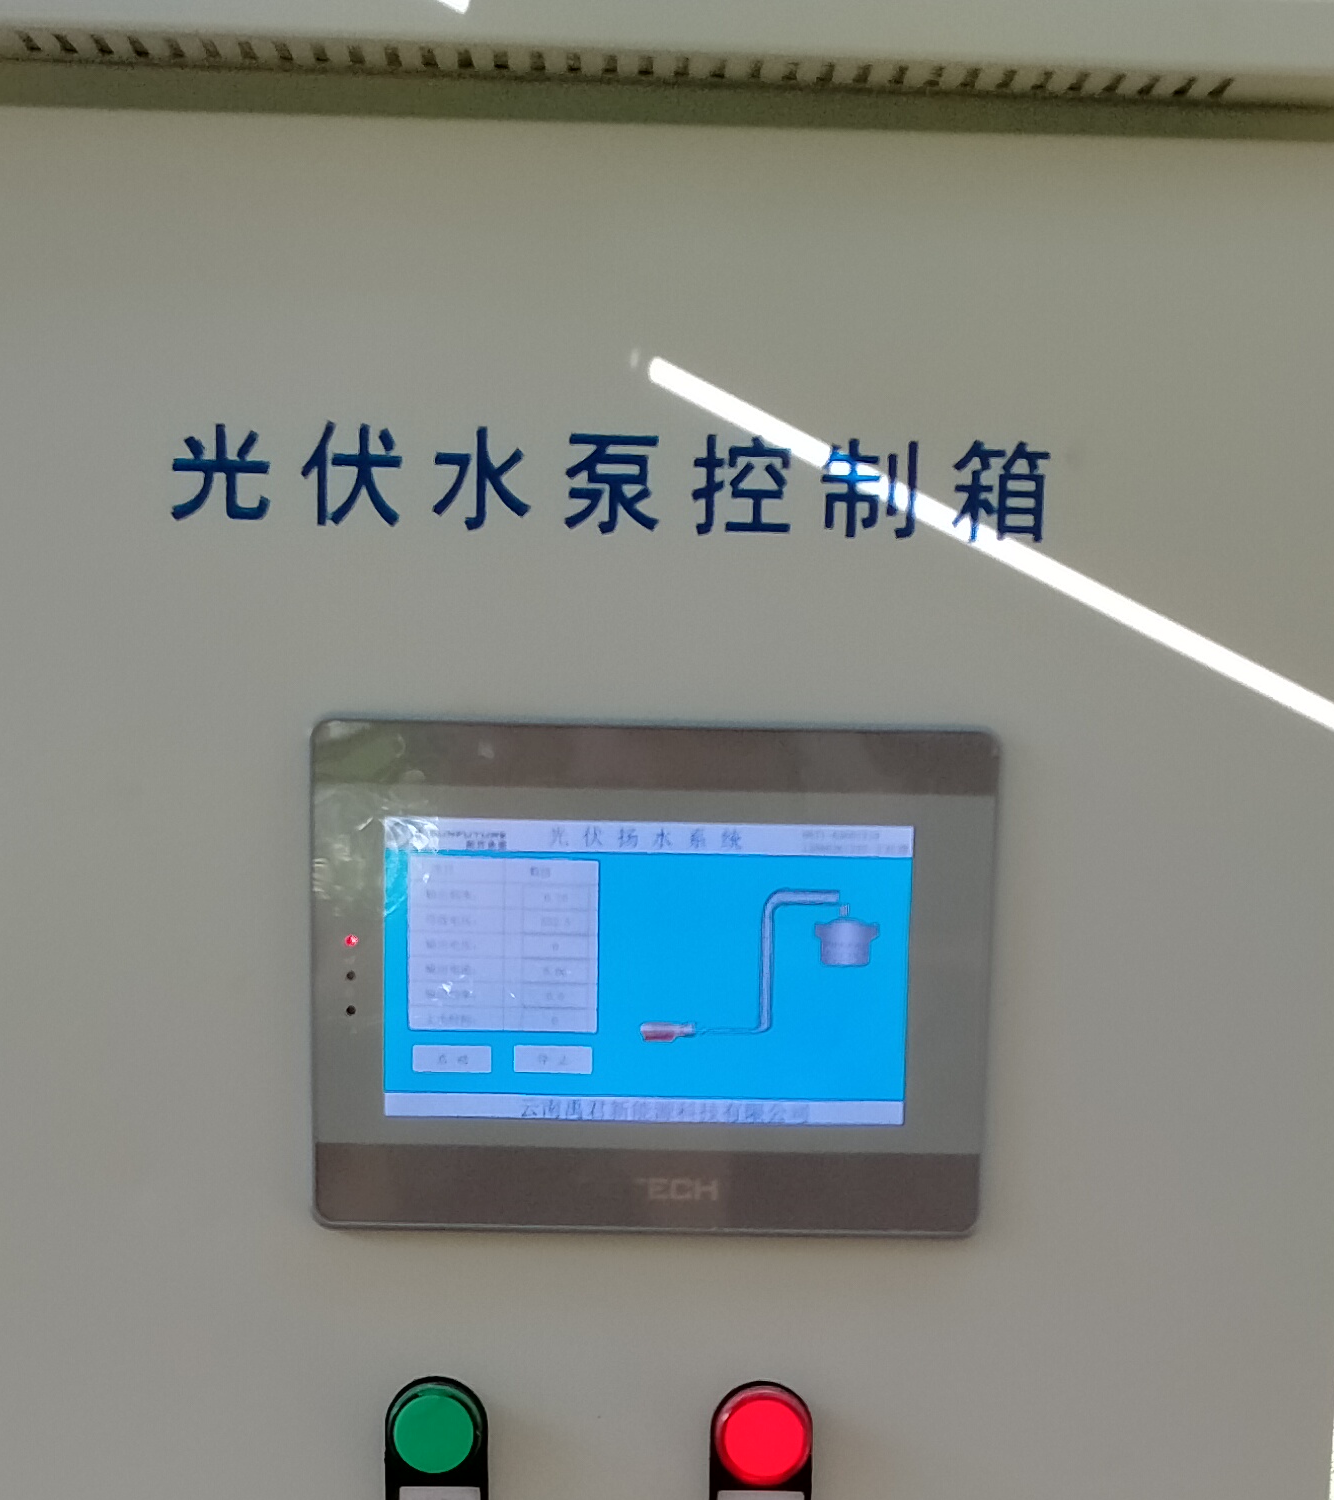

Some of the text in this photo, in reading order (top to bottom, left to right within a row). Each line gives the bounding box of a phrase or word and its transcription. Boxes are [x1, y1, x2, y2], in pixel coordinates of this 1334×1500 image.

[171, 420, 1051, 544] 光伏水泵控制箱
[549, 827, 743, 850] 光伏扬水系统
